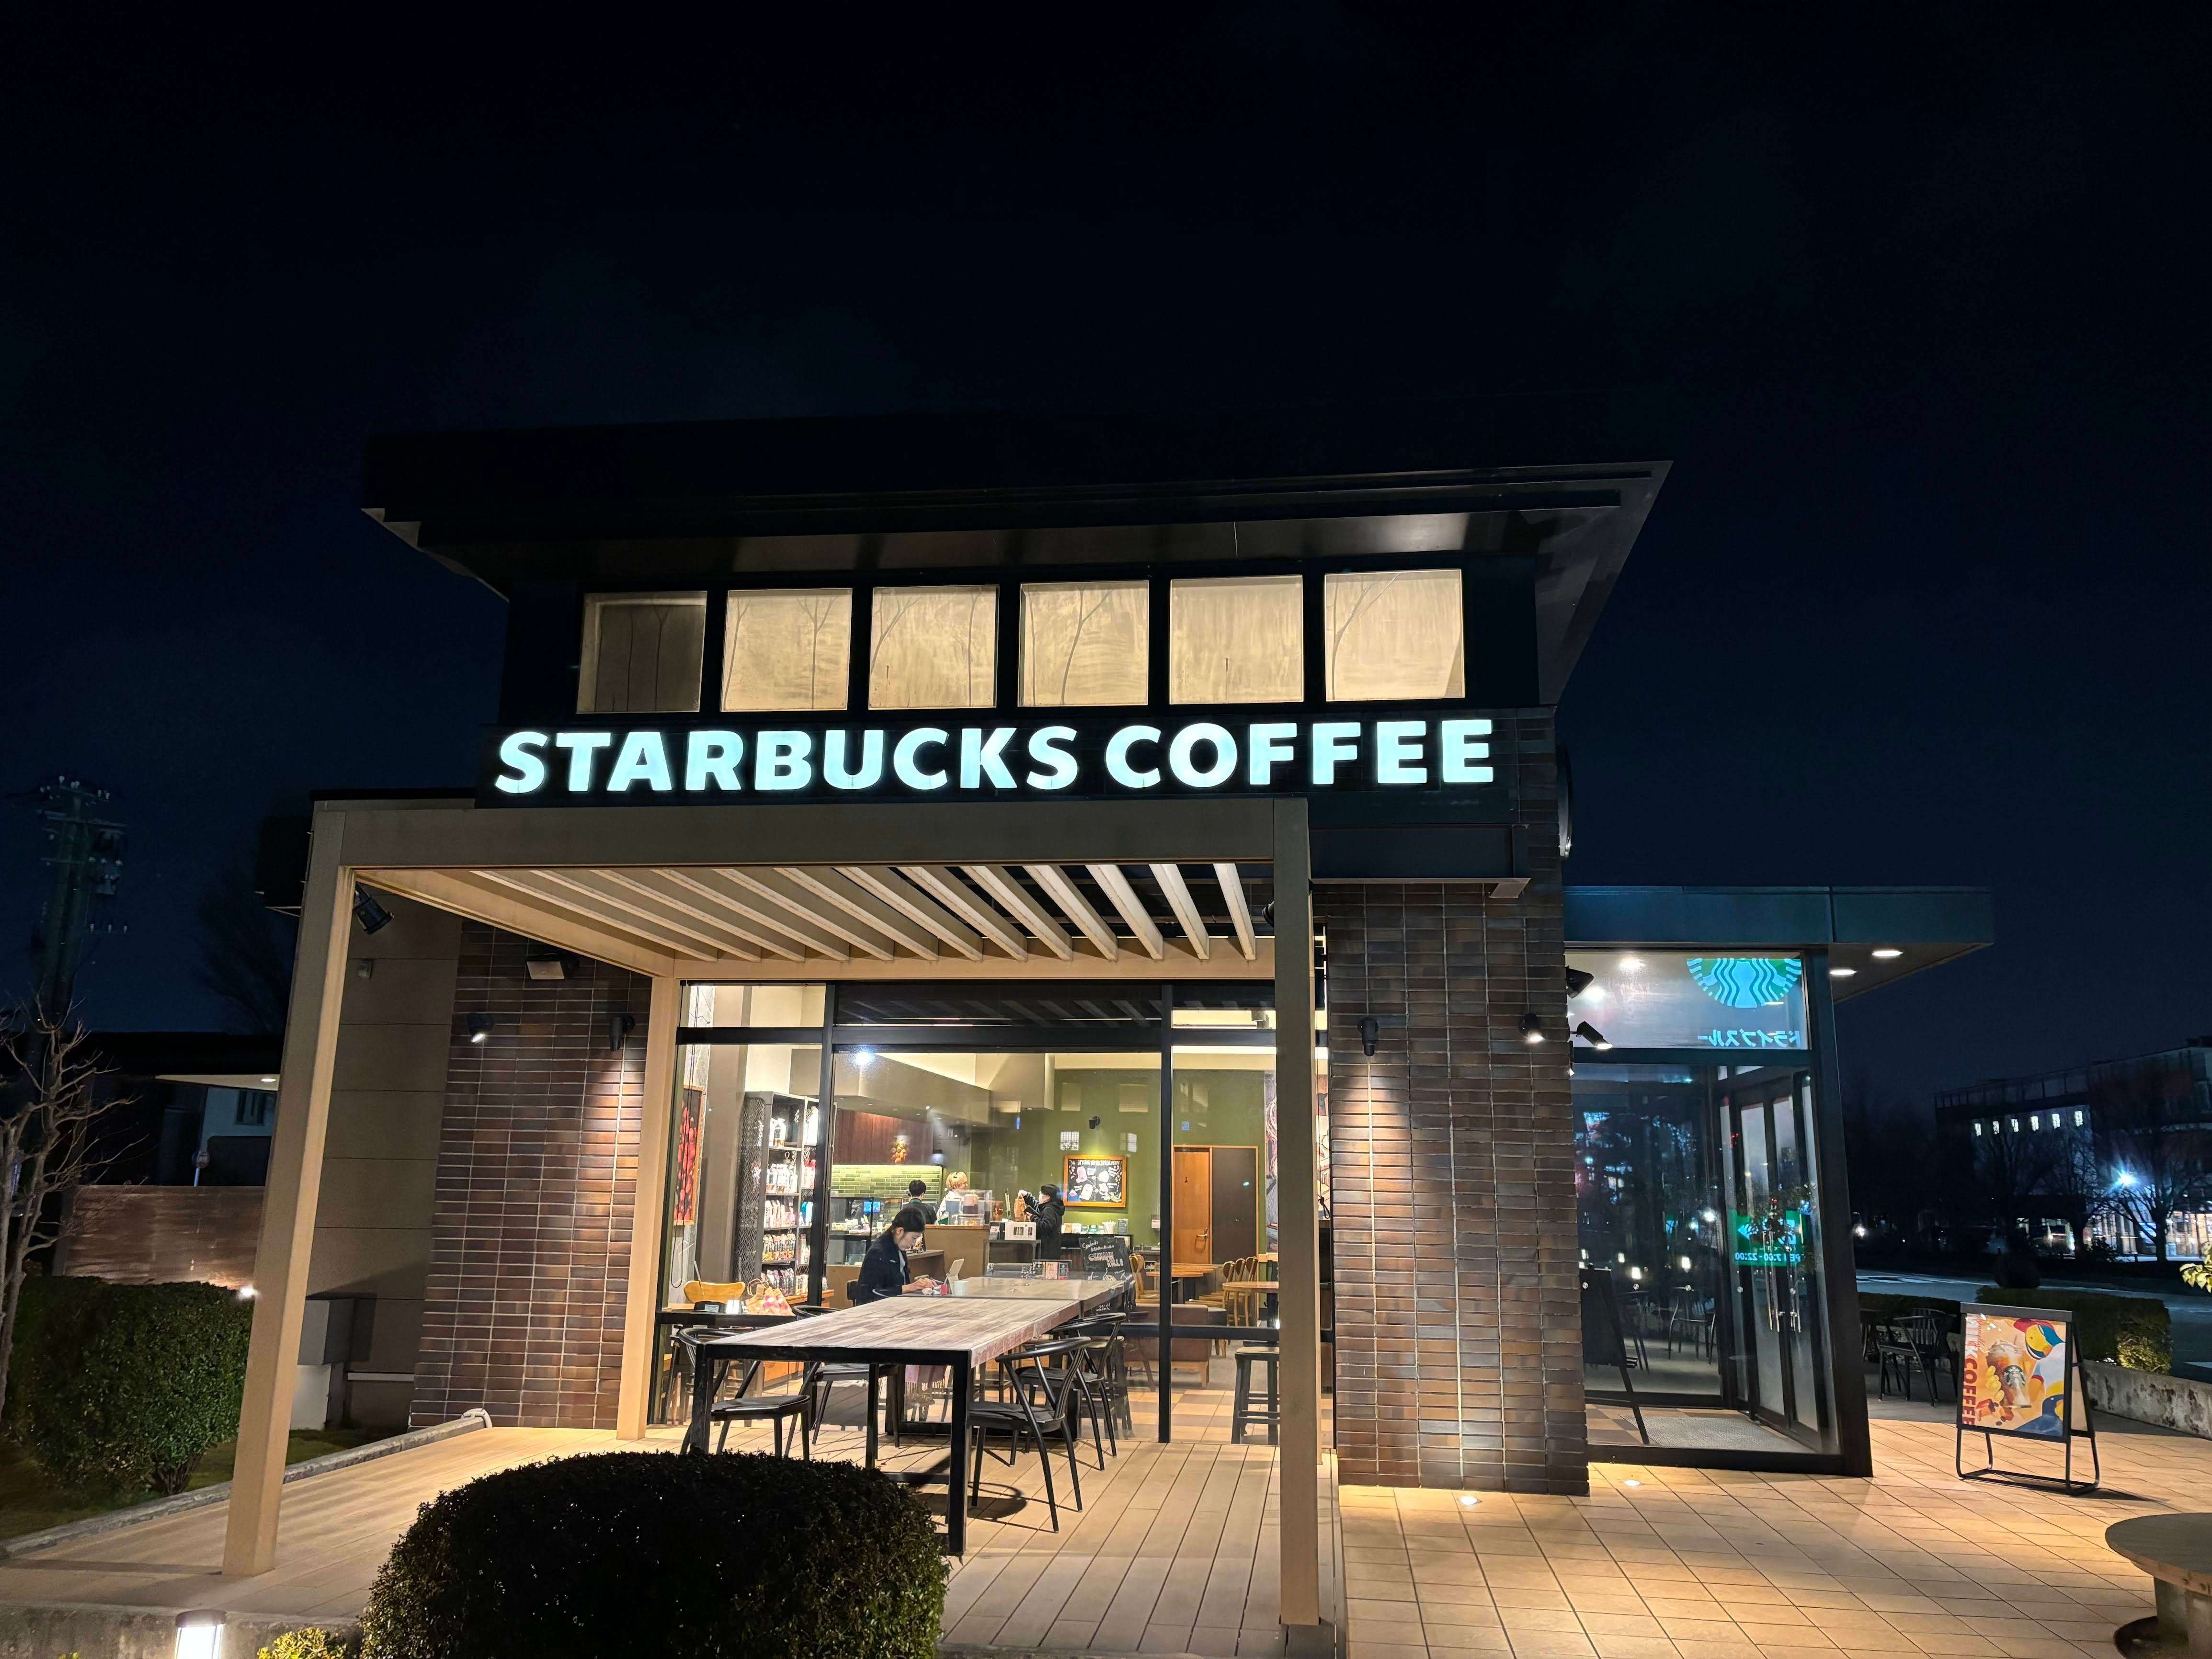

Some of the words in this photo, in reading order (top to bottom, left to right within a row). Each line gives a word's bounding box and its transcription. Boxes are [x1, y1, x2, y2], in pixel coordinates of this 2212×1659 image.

[495, 726, 1078, 794] STARBUCKS
[1105, 719, 1494, 788] COFFEE
[1961, 1358, 1978, 1425] COFFEE
